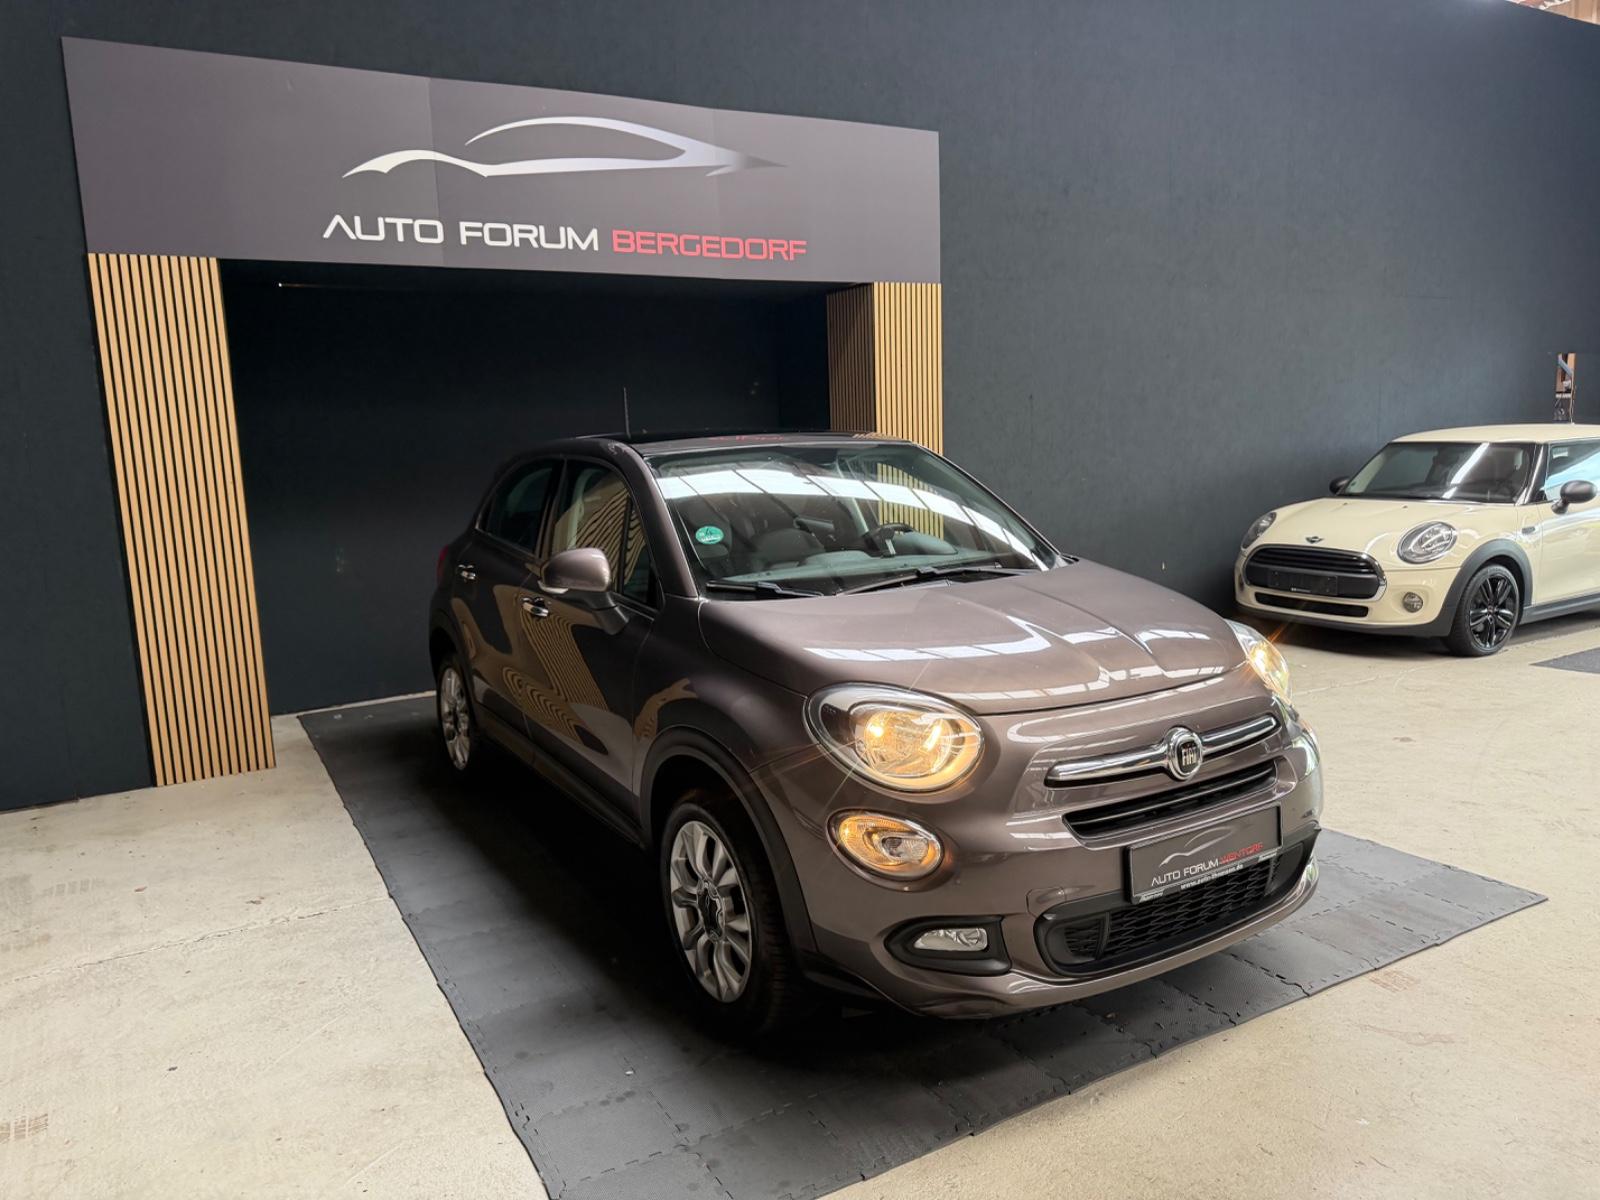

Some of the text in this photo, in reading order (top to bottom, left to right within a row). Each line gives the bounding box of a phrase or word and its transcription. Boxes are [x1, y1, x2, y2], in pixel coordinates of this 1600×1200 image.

[323, 214, 807, 261] AUTO FORUM BERGEDORF
[1151, 869, 1181, 887] AUTO
[1183, 858, 1219, 877] FORUM
